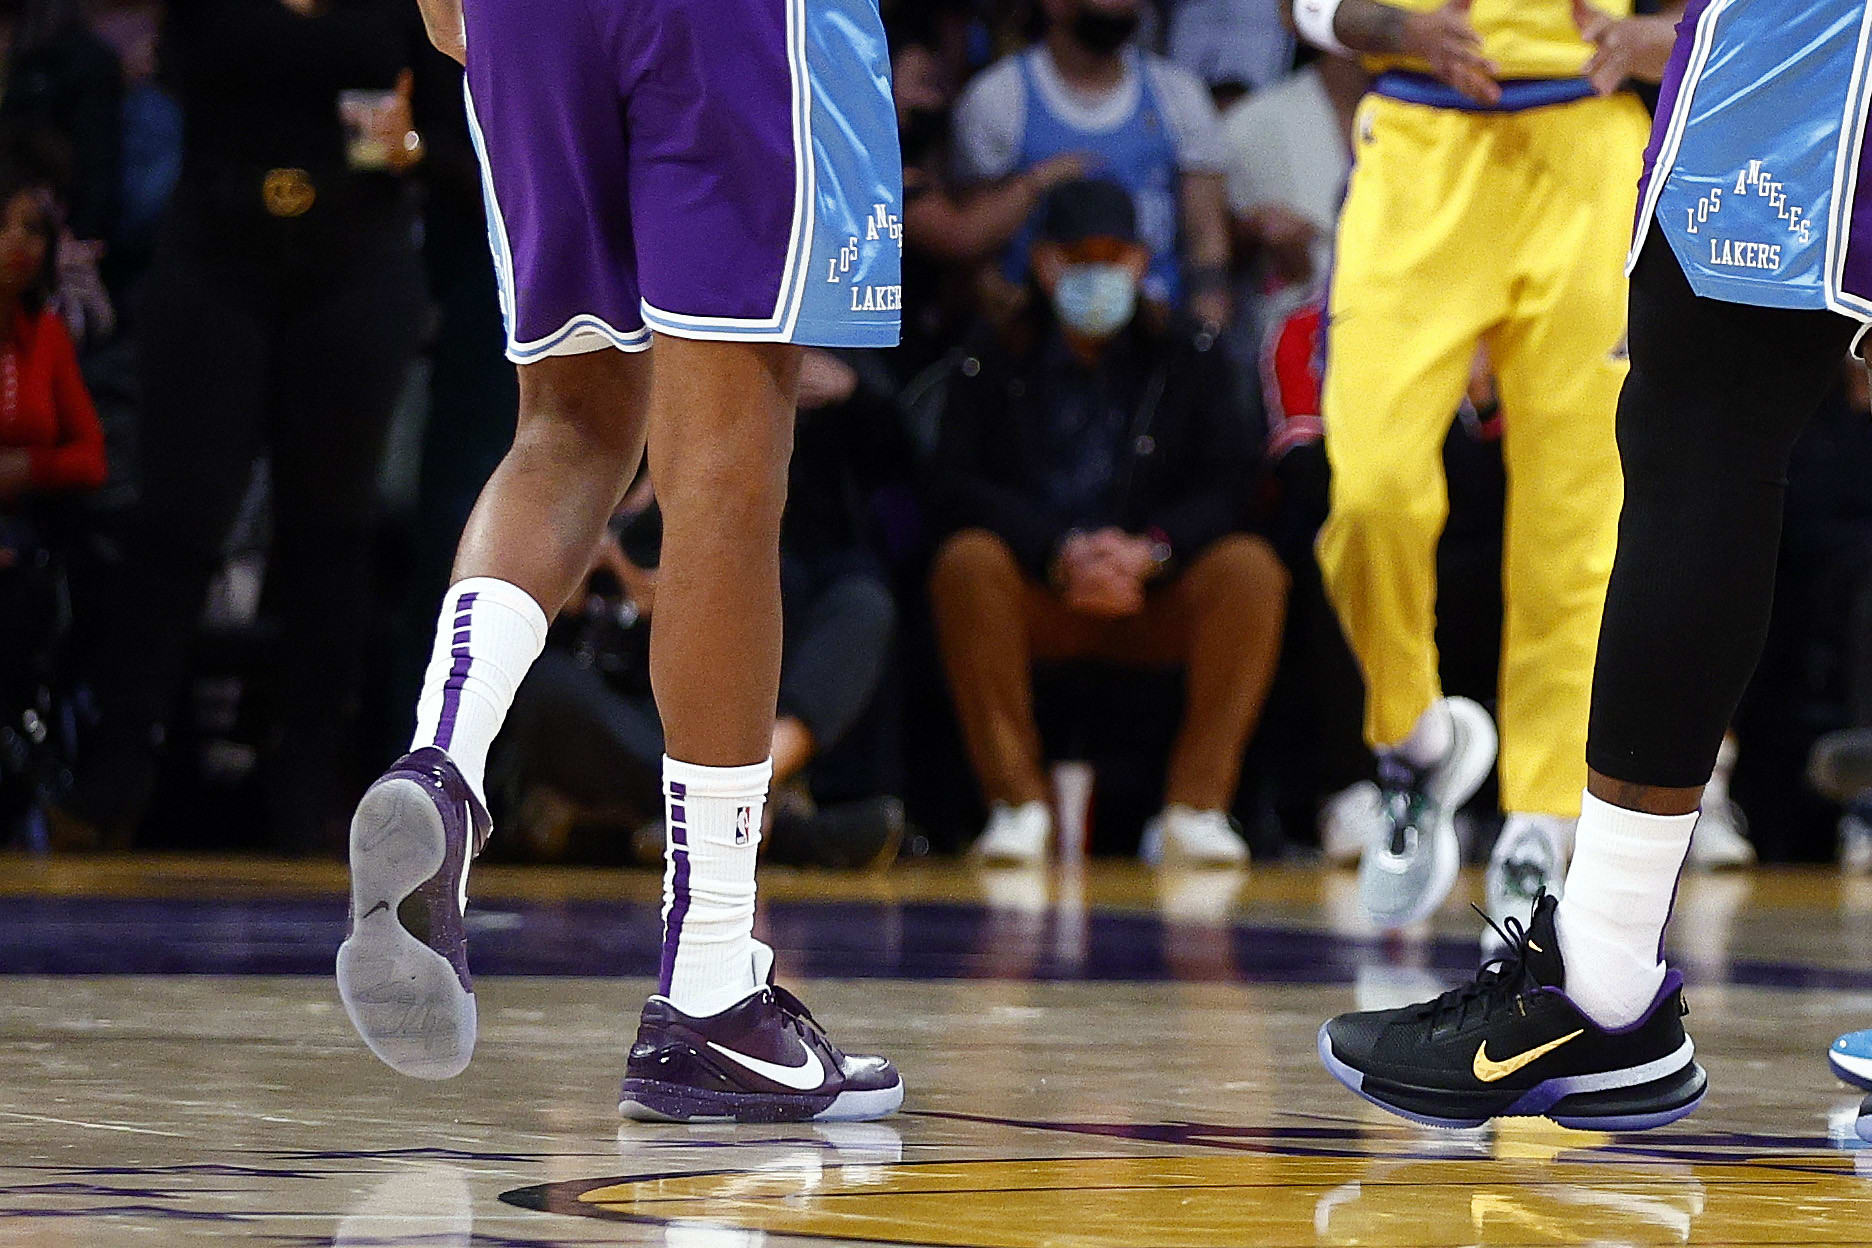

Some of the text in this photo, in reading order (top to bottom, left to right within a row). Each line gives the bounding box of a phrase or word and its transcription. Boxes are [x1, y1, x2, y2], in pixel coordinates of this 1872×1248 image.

[1687, 159, 1811, 243] LOS ANGELES
[827, 237, 858, 282] LOS
[1710, 239, 1781, 270] LAKERS
